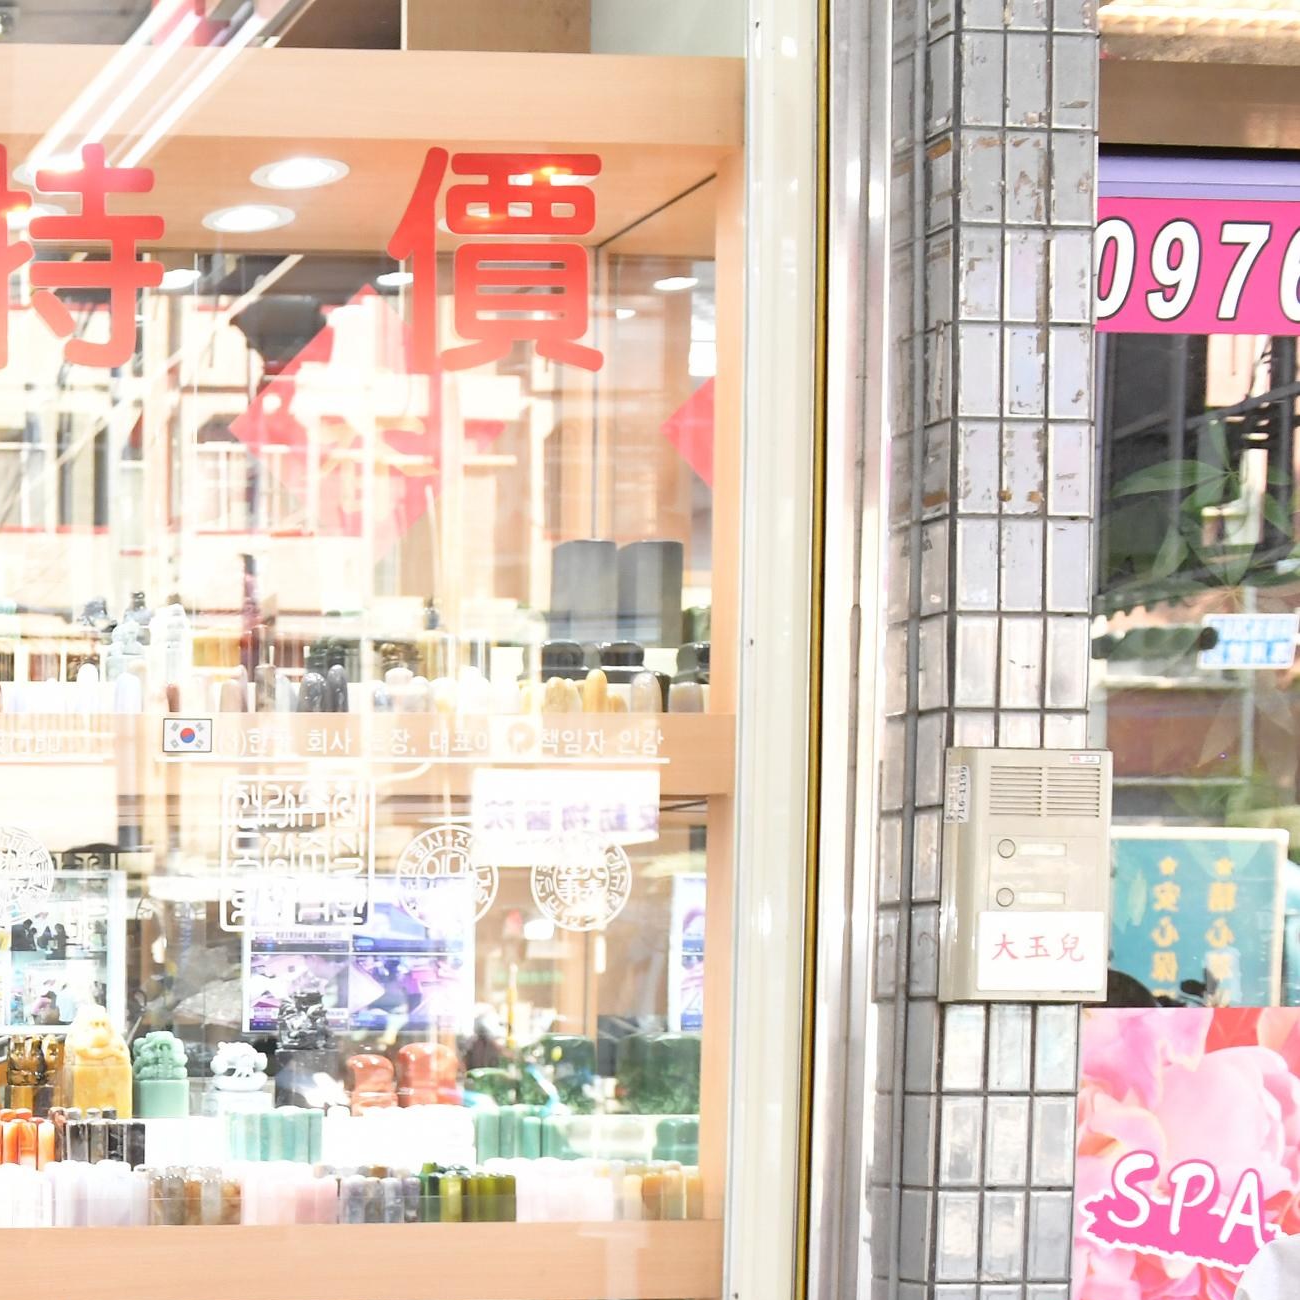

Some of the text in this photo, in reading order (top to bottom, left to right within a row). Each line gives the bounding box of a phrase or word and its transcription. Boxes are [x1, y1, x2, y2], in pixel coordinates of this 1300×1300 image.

[991, 933, 1085, 963] 大玉兒
[1109, 1149, 1267, 1249] SPA
